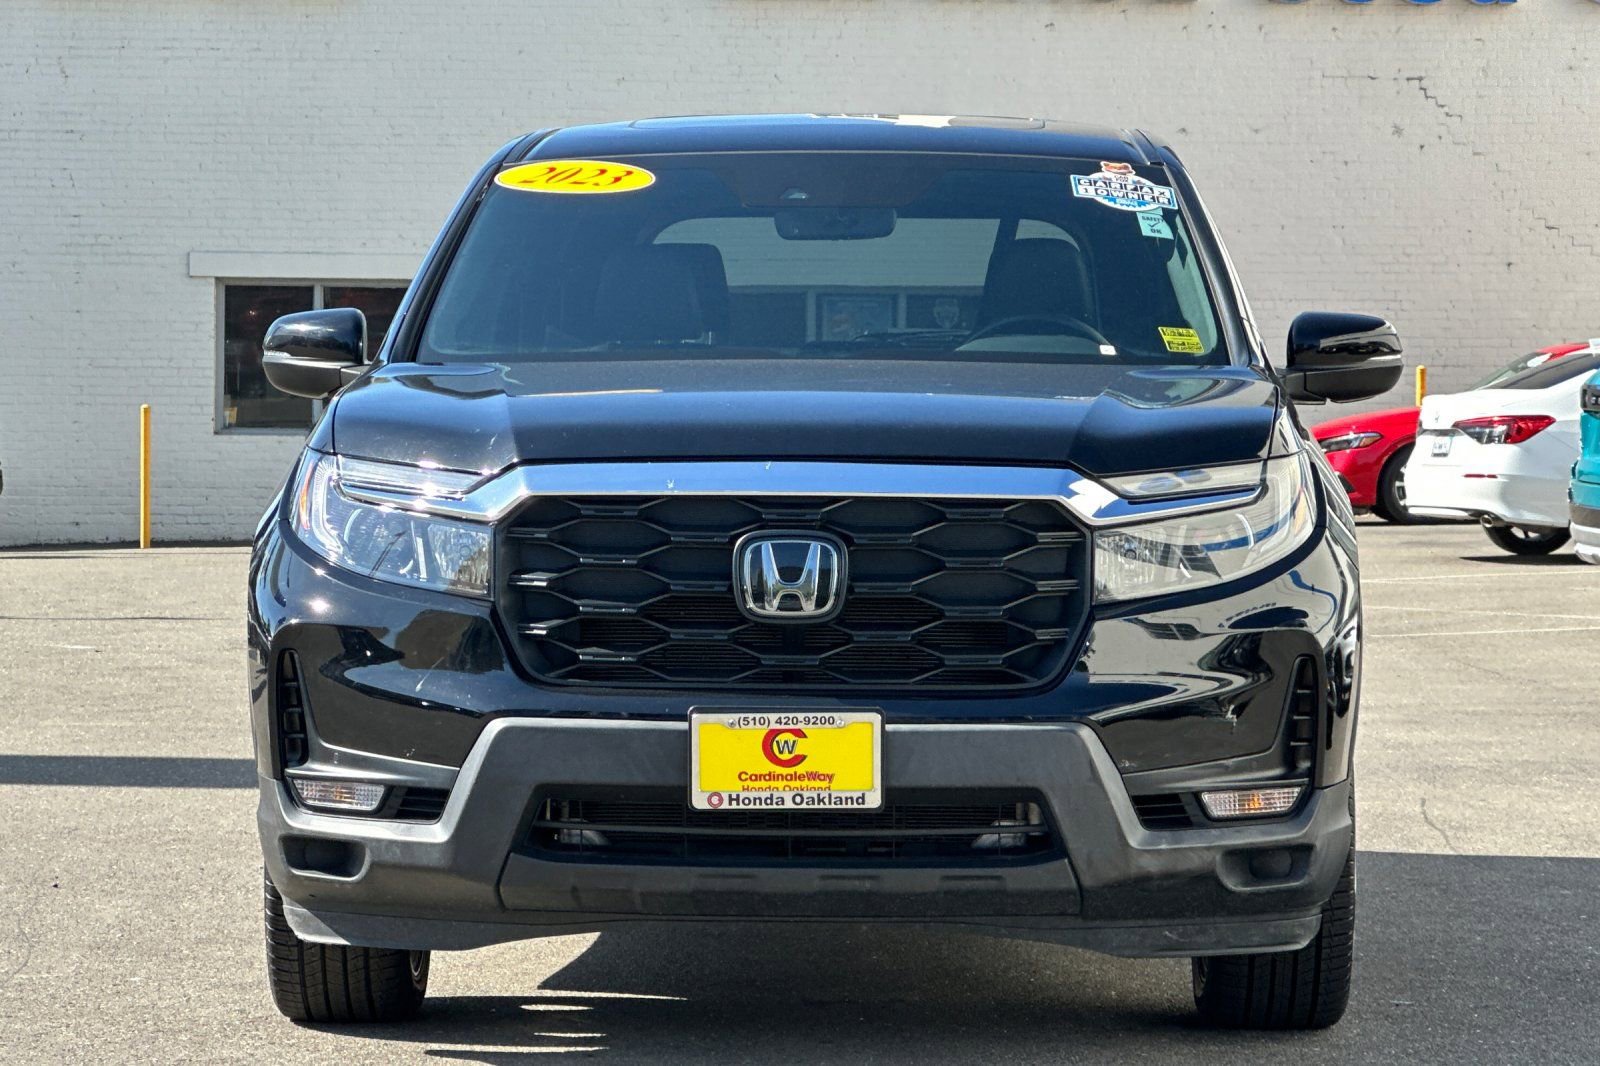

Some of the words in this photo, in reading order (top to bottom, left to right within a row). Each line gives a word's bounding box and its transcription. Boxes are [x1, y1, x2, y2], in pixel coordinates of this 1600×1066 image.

[518, 166, 634, 187] 2023
[1079, 178, 1168, 198] CARFAX
[1097, 189, 1169, 205] OWNER
[1141, 215, 1164, 223] SAFETY
[737, 716, 771, 728] (510)
[774, 715, 835, 726] 420-9200
[737, 771, 836, 784] CardinaleWay
[728, 793, 785, 807] Honda
[791, 792, 866, 807] Oakland
